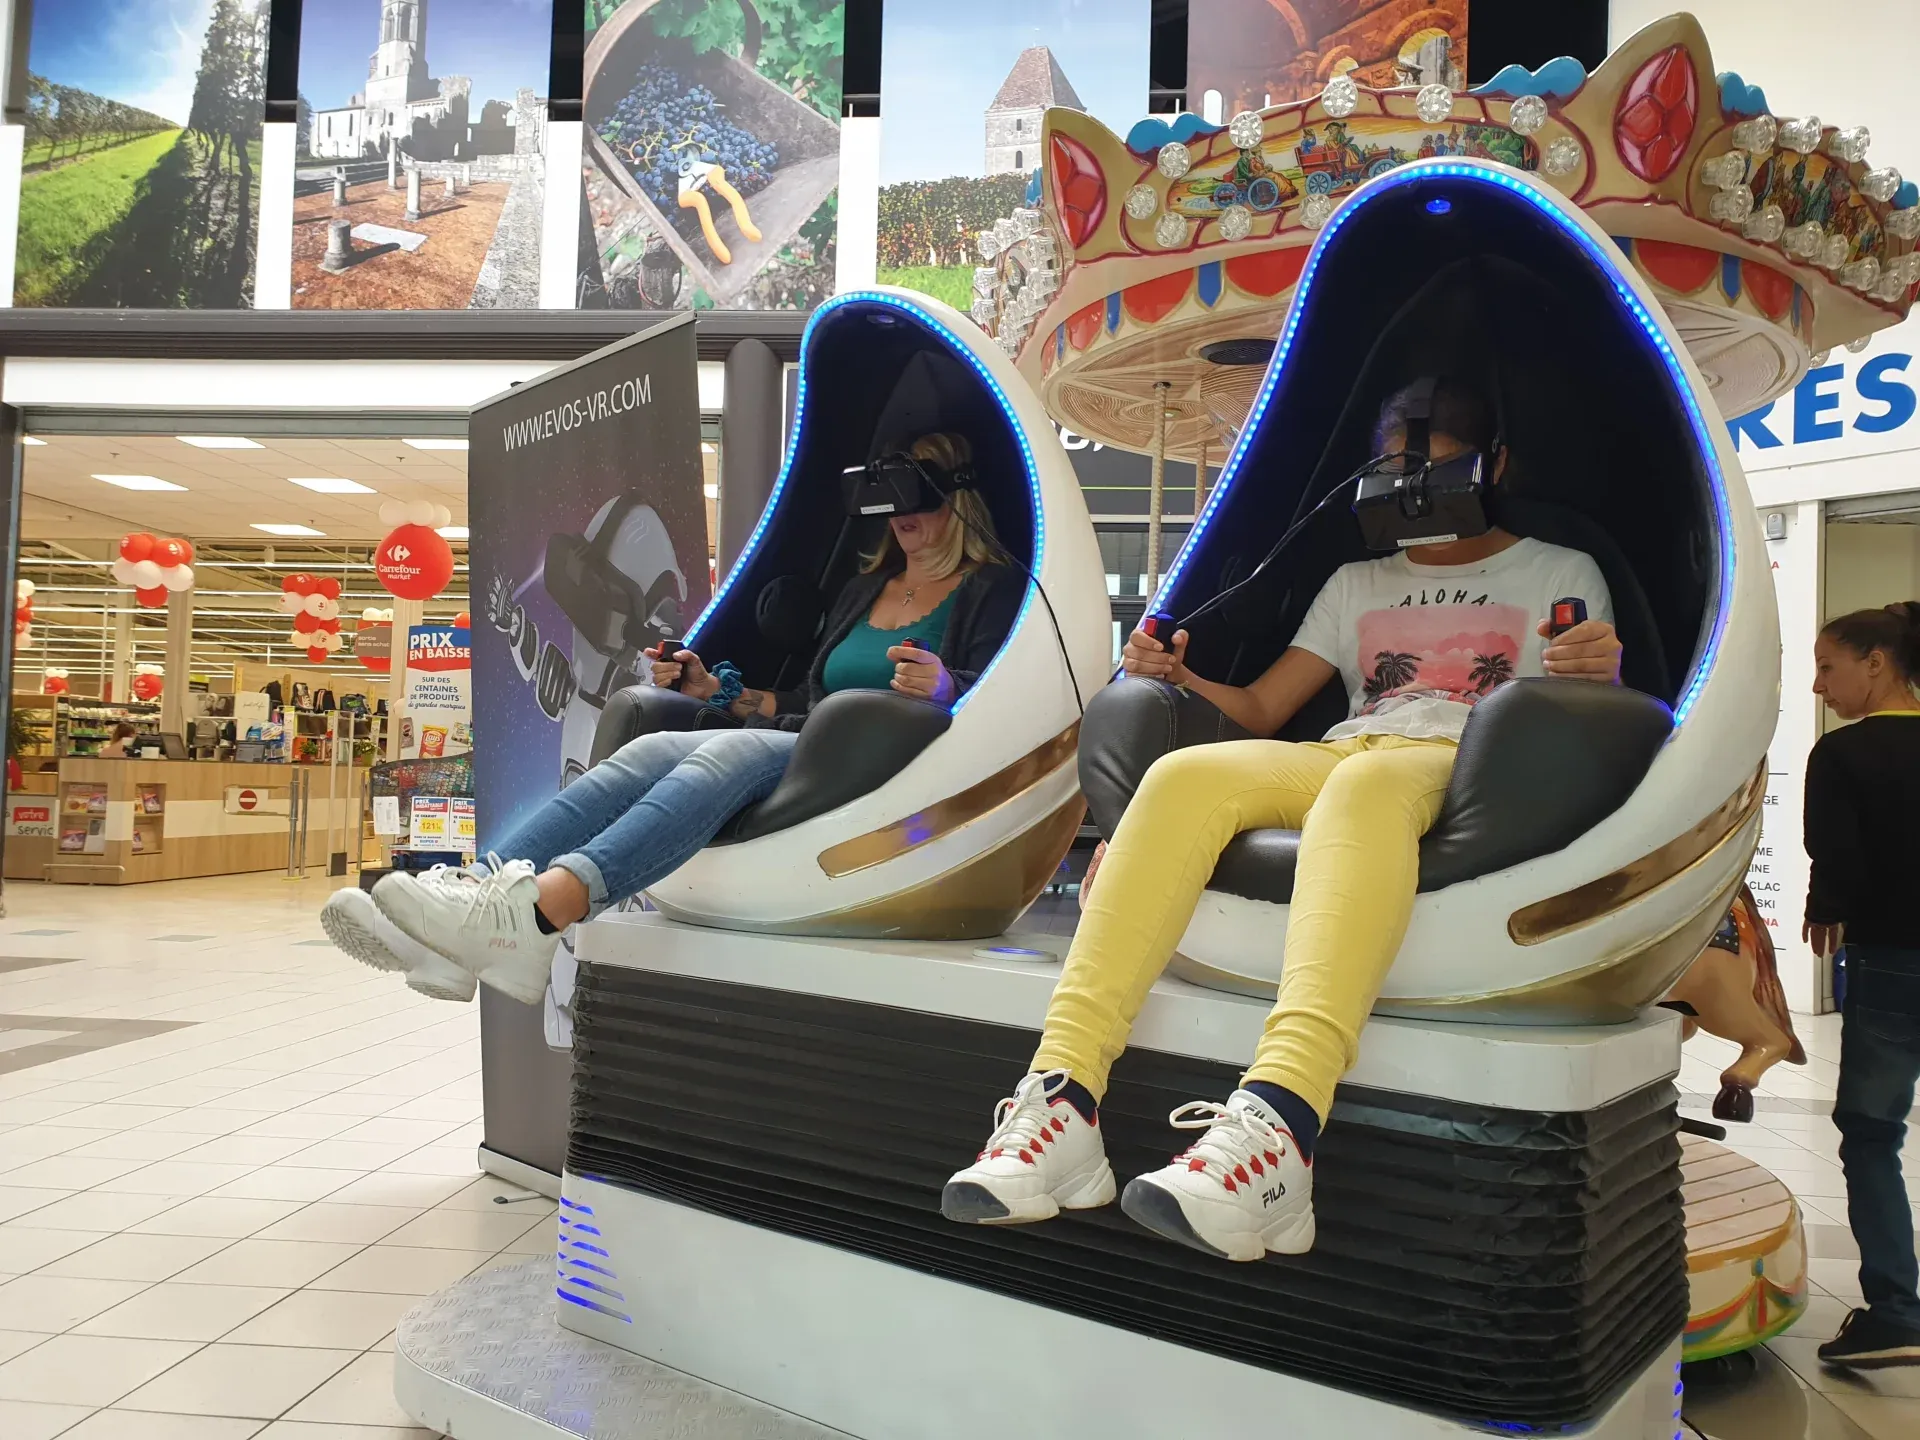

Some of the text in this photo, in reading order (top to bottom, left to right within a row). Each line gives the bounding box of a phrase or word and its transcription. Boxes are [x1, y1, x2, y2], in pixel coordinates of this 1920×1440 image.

[503, 374, 652, 452] WWW.EVOS-VR.COM
[378, 563, 422, 575] Carrefour
[410, 632, 454, 650] PRIX
[409, 647, 471, 660] EN BAISSE
[414, 684, 458, 693] CENTAINES
[415, 701, 438, 710] grandes
[439, 703, 466, 711] marques
[421, 822, 436, 830] 121
[488, 937, 517, 950] FILA
[1262, 1181, 1286, 1209] FILA
